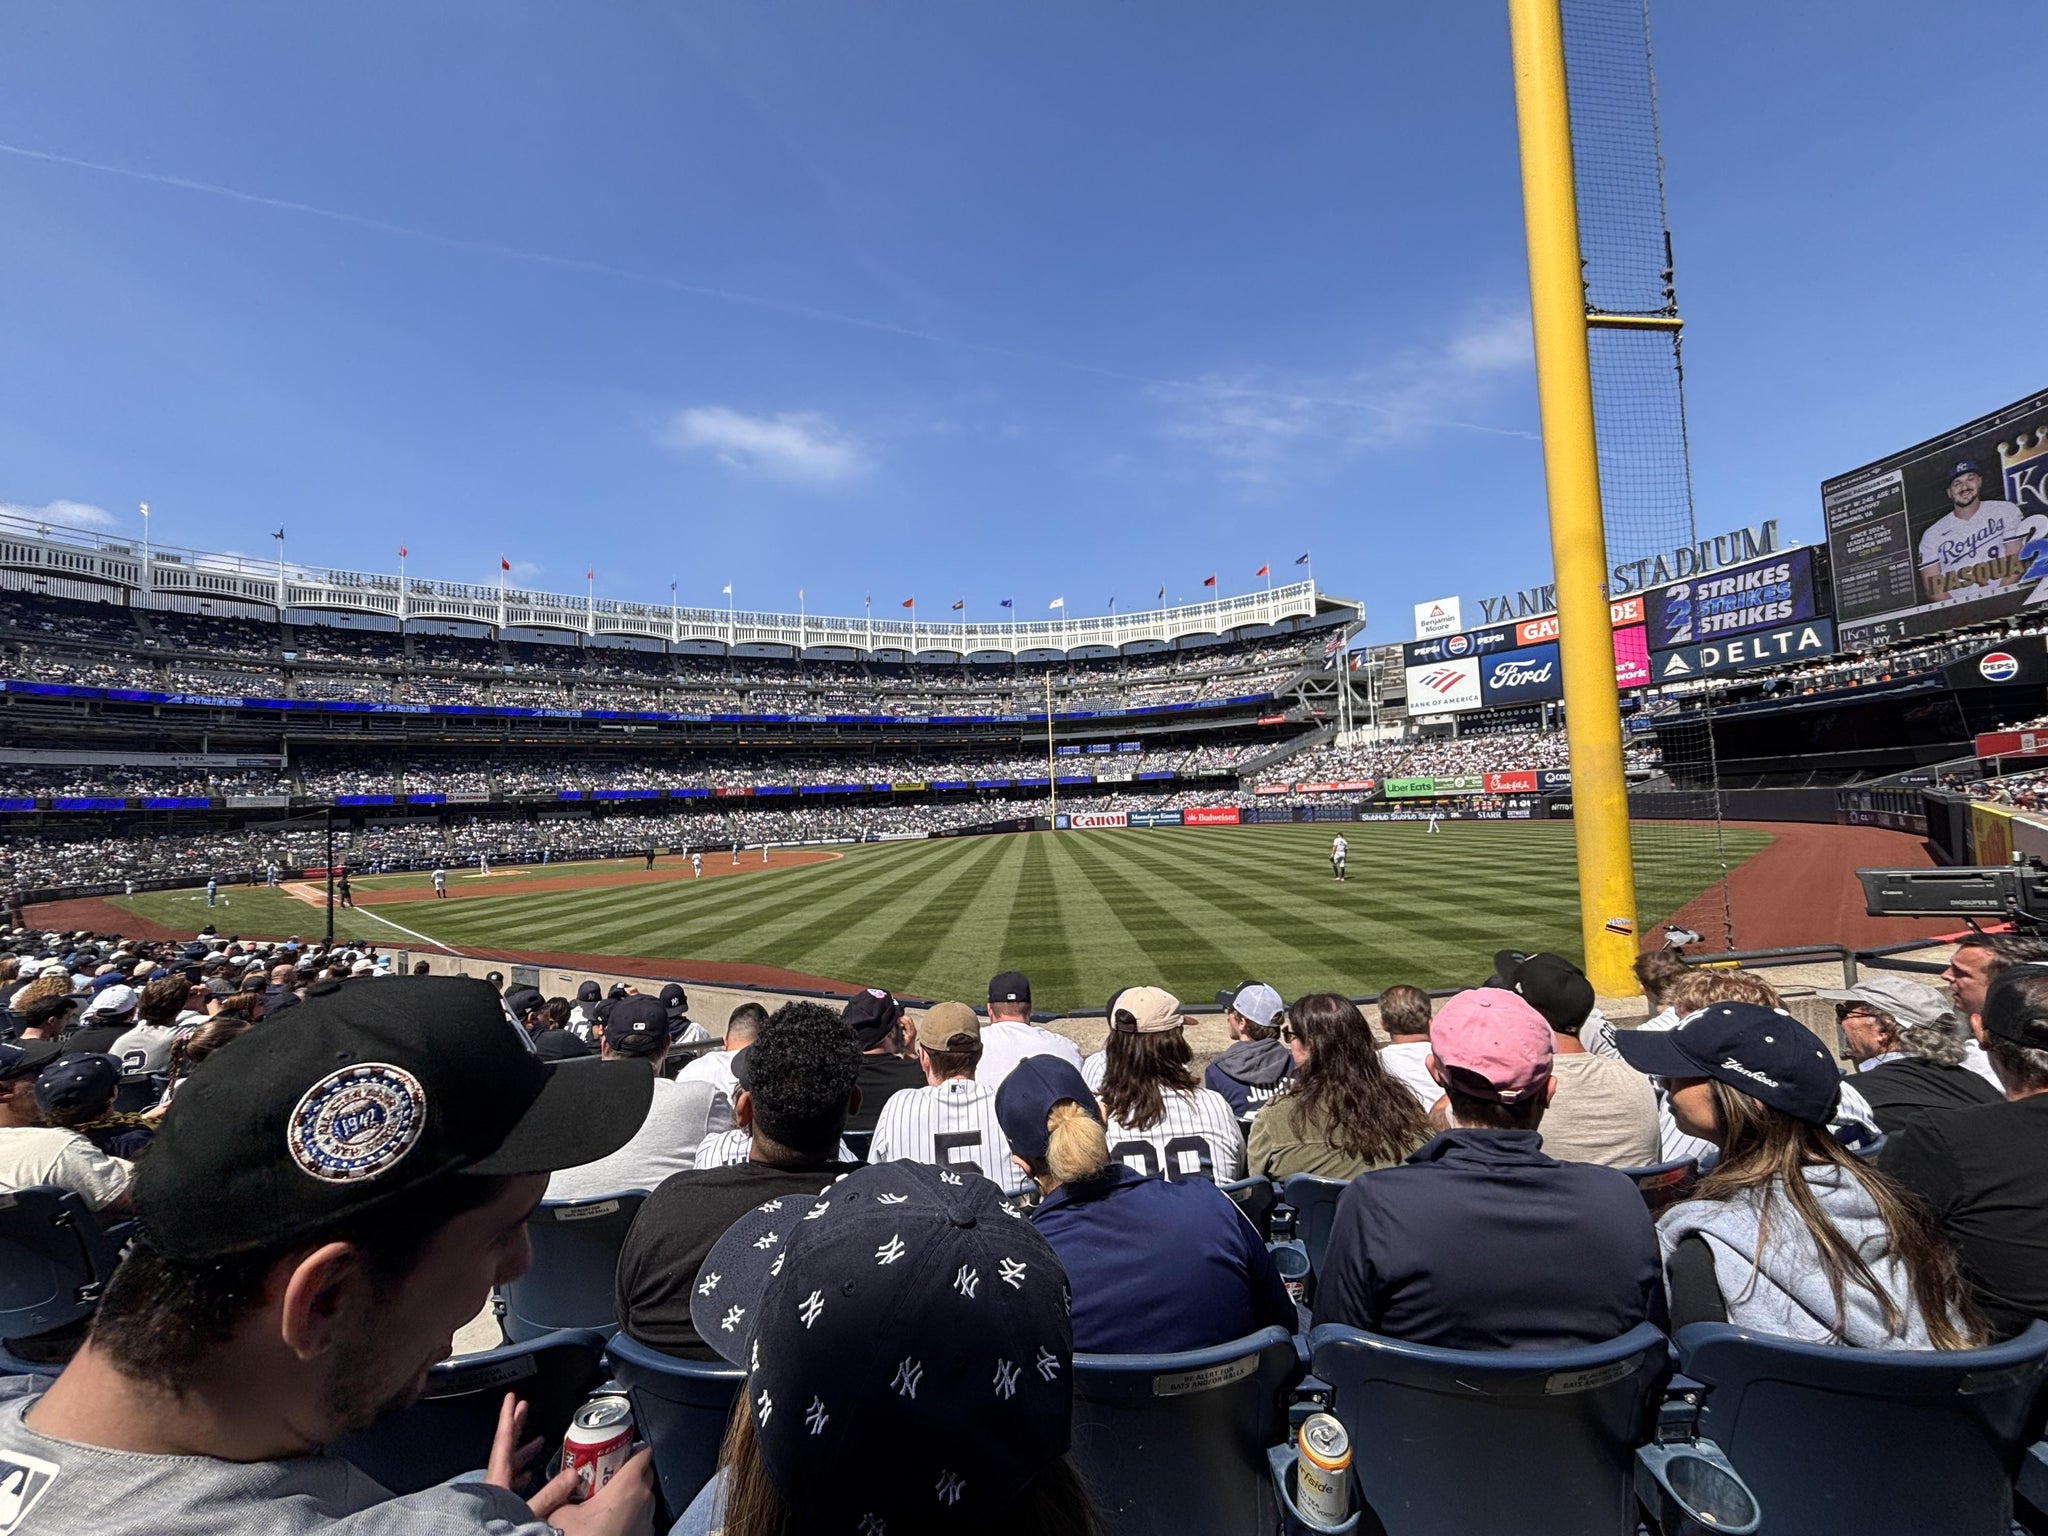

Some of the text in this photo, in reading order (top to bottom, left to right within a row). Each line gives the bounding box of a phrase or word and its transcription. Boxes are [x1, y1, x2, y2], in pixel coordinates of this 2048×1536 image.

[1874, 529, 1891, 538] FIRST
[1938, 517, 2004, 564] Royals
[1613, 519, 1778, 595] STADIUM
[1697, 563, 1790, 600] STRIKES
[1928, 553, 2028, 595] PASQUA
[1666, 581, 1792, 629] 2 STRIKES
[1698, 600, 1793, 634] STRIKES
[1421, 615, 1455, 628] Benjamin
[1425, 623, 1450, 633] Moore
[1874, 624, 1887, 633] KC
[1414, 645, 1440, 656] PEPSI
[1477, 634, 1505, 645] PEPSI
[1700, 627, 1822, 668] DELTA
[1873, 635, 1890, 645] NYY
[1489, 659, 1552, 689] Ford
[1983, 663, 2015, 671] PEPSI
[1410, 700, 1430, 708] BANK
[1444, 695, 1479, 704] AMERICA
[725, 788, 745, 796] AVIS
[1387, 784, 1407, 793] Uber
[1410, 783, 1432, 791] Eats
[1072, 814, 1126, 827] Canon
[1199, 813, 1237, 822] Budweiser
[1362, 813, 1388, 821] StubHub
[1721, 1057, 1779, 1088] Yankees
[875, 1234, 905, 1265] NY
[698, 1272, 722, 1296] NY
[953, 1264, 980, 1298] NY
[998, 1257, 1027, 1289] NY
[721, 1305, 745, 1332] NY
[798, 1290, 825, 1329] NY
[890, 1356, 924, 1399] NY
[993, 1358, 1022, 1400] NY
[1191, 1376, 1222, 1388] AND/OR
[1223, 1368, 1245, 1381] BALLS
[1195, 1371, 1219, 1381] ALERT
[1220, 1367, 1234, 1375] FOR
[805, 1395, 829, 1435] NY
